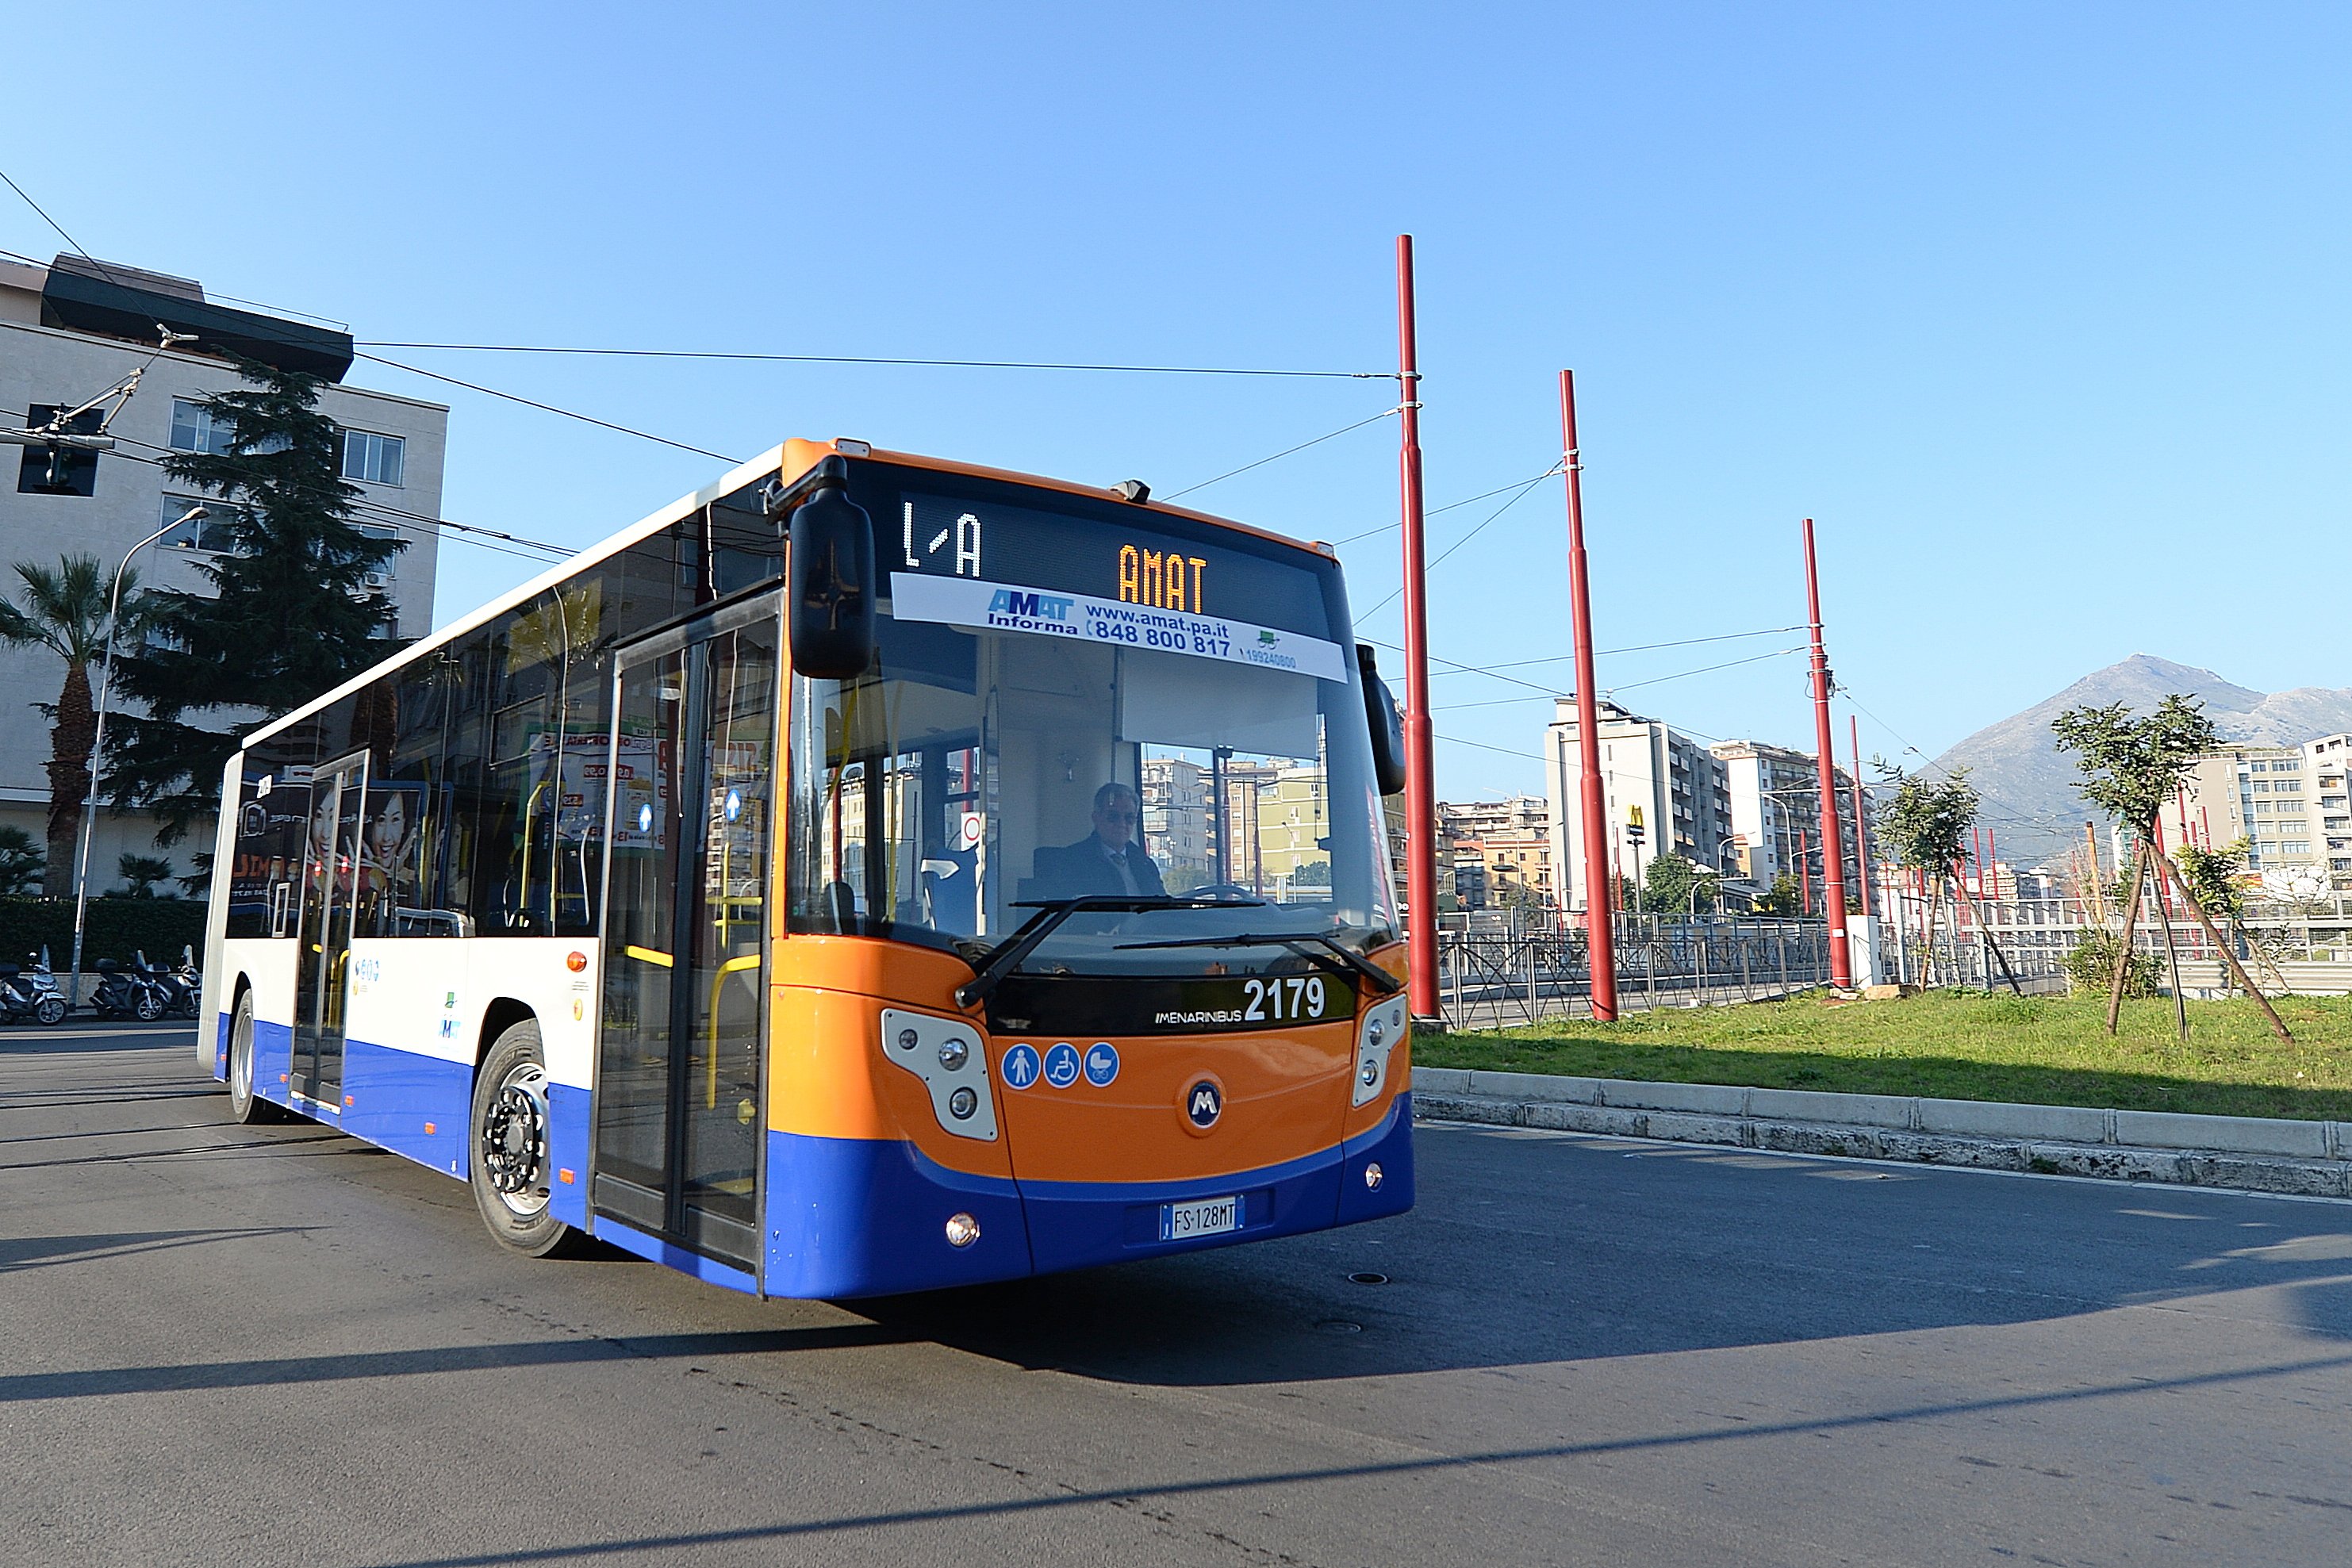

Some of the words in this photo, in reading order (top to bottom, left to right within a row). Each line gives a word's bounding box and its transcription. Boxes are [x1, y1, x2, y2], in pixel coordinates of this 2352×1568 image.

[1119, 544, 1207, 614] AMAT
[988, 588, 1074, 621] AMAT
[1085, 604, 1229, 638] www.amat.pa.it
[988, 613, 1078, 635] Informa
[1095, 621, 1139, 642] 848
[1146, 629, 1187, 650] 800
[1193, 636, 1231, 657] 817
[1246, 649, 1297, 669] 199240800
[1244, 976, 1325, 1022] 2179
